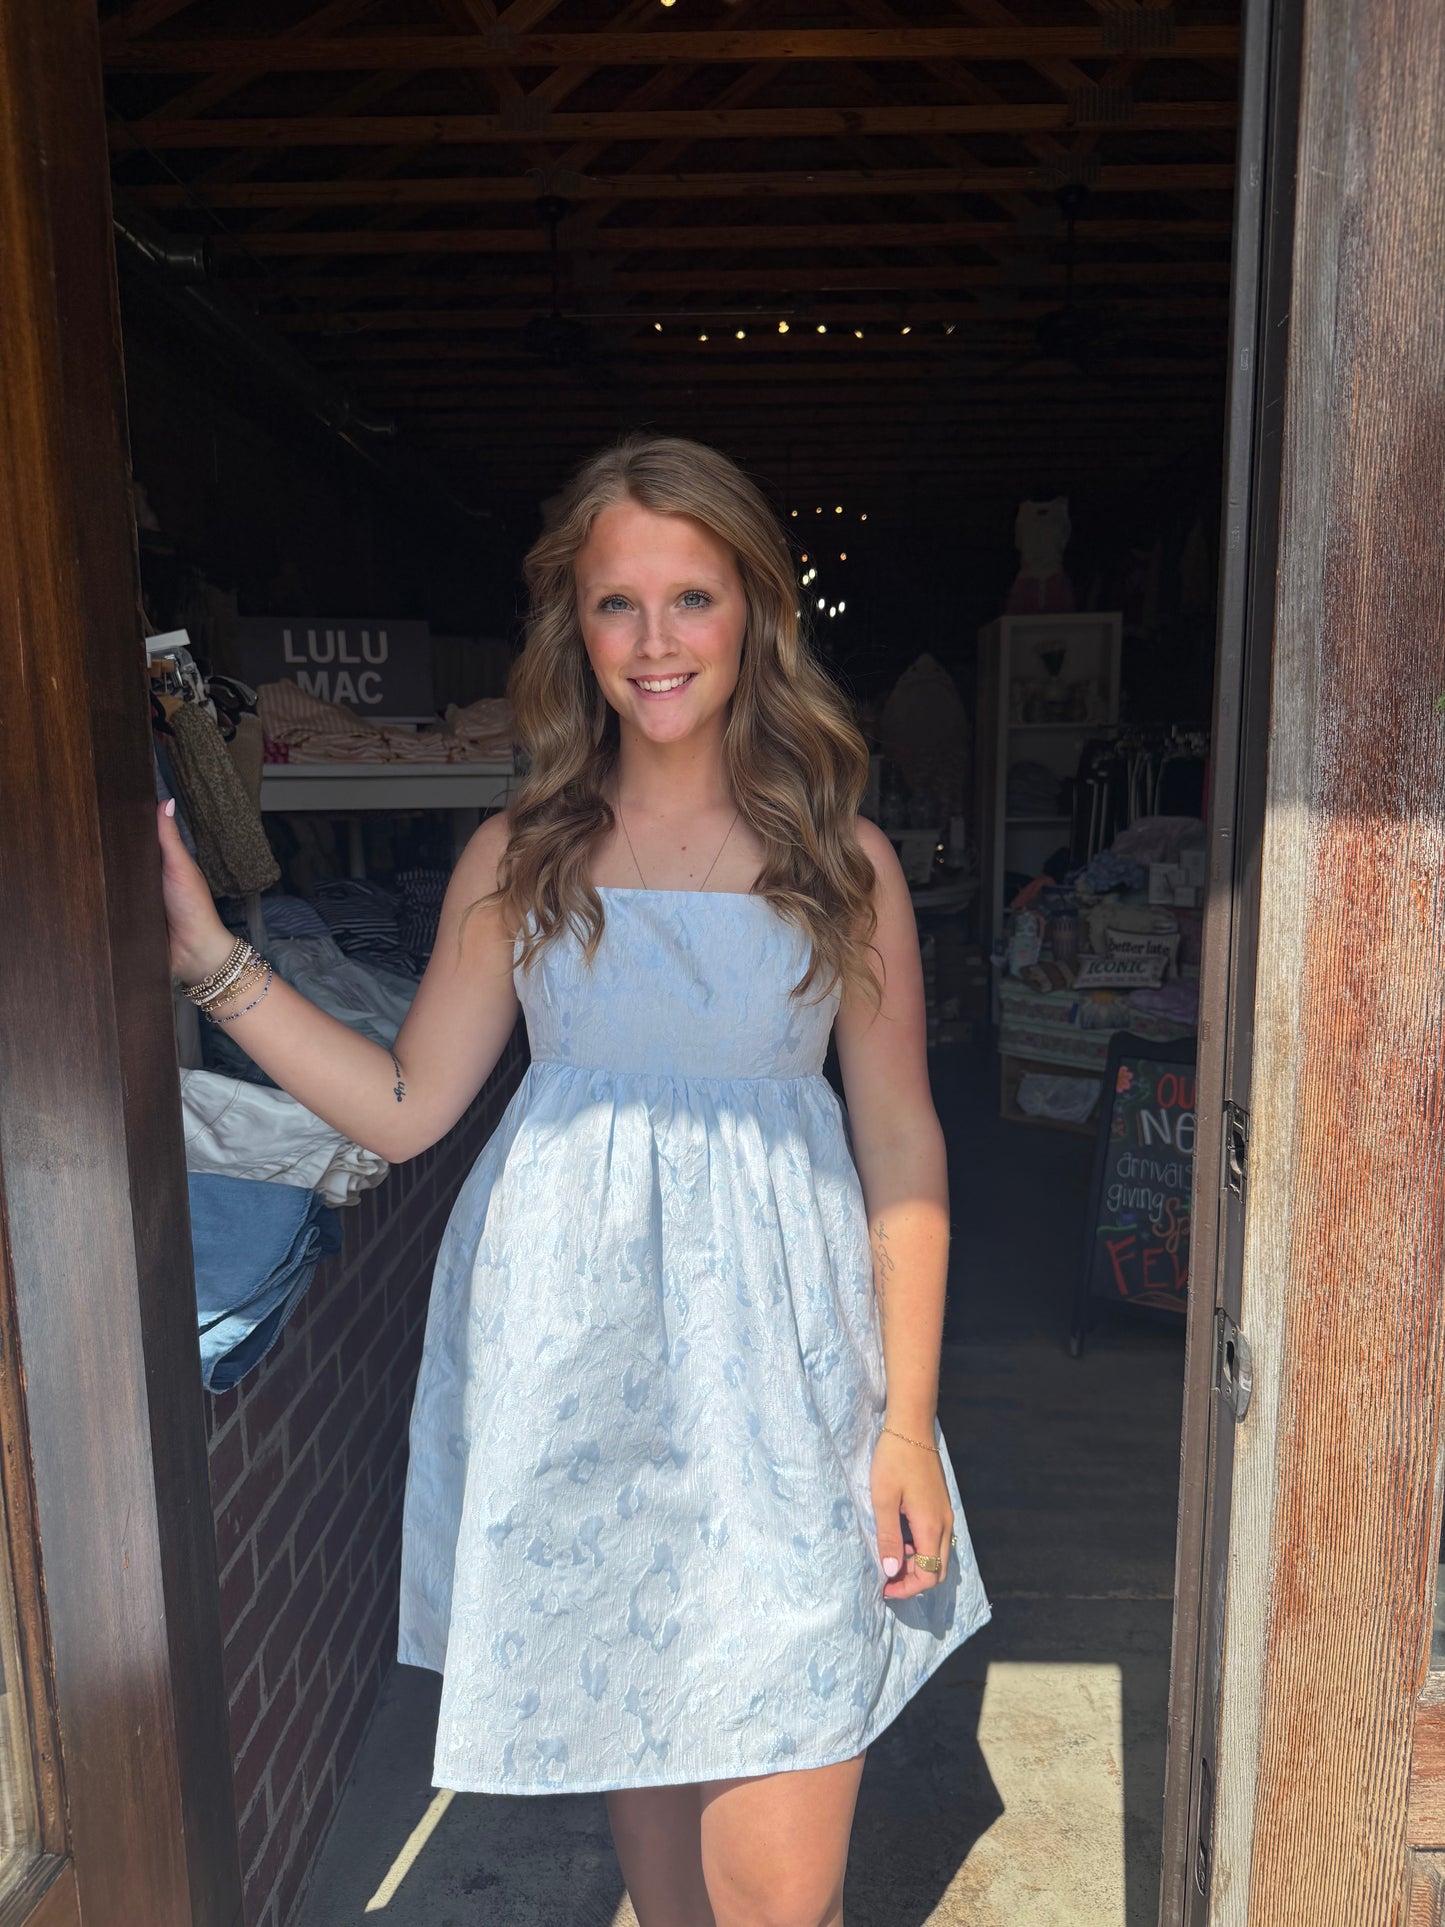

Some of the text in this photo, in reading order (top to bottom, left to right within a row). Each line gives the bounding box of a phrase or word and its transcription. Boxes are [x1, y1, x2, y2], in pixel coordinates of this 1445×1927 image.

[282, 629, 389, 664] LULU
[296, 671, 384, 705] MAC
[1108, 938, 1145, 954] better
[1086, 960, 1148, 974] ICONIC
[1106, 1183, 1166, 1223] giving
